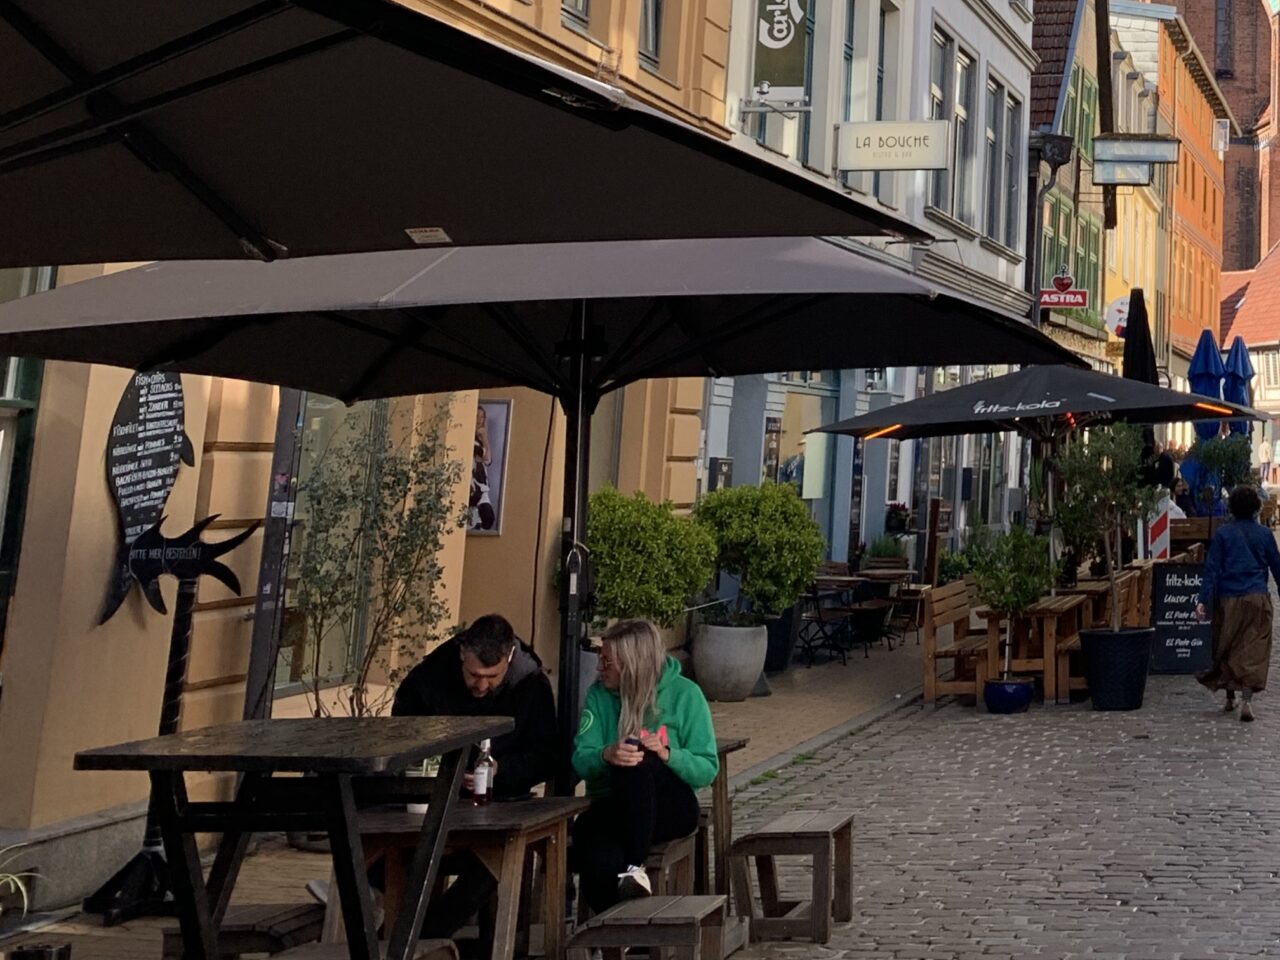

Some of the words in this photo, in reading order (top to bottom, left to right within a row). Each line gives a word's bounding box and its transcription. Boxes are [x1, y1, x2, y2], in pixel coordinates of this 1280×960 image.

[856, 136, 871, 149] LA
[878, 135, 929, 148] BOUCHE
[1041, 294, 1083, 303] ASTRA
[973, 399, 1060, 414] fritz-kola
